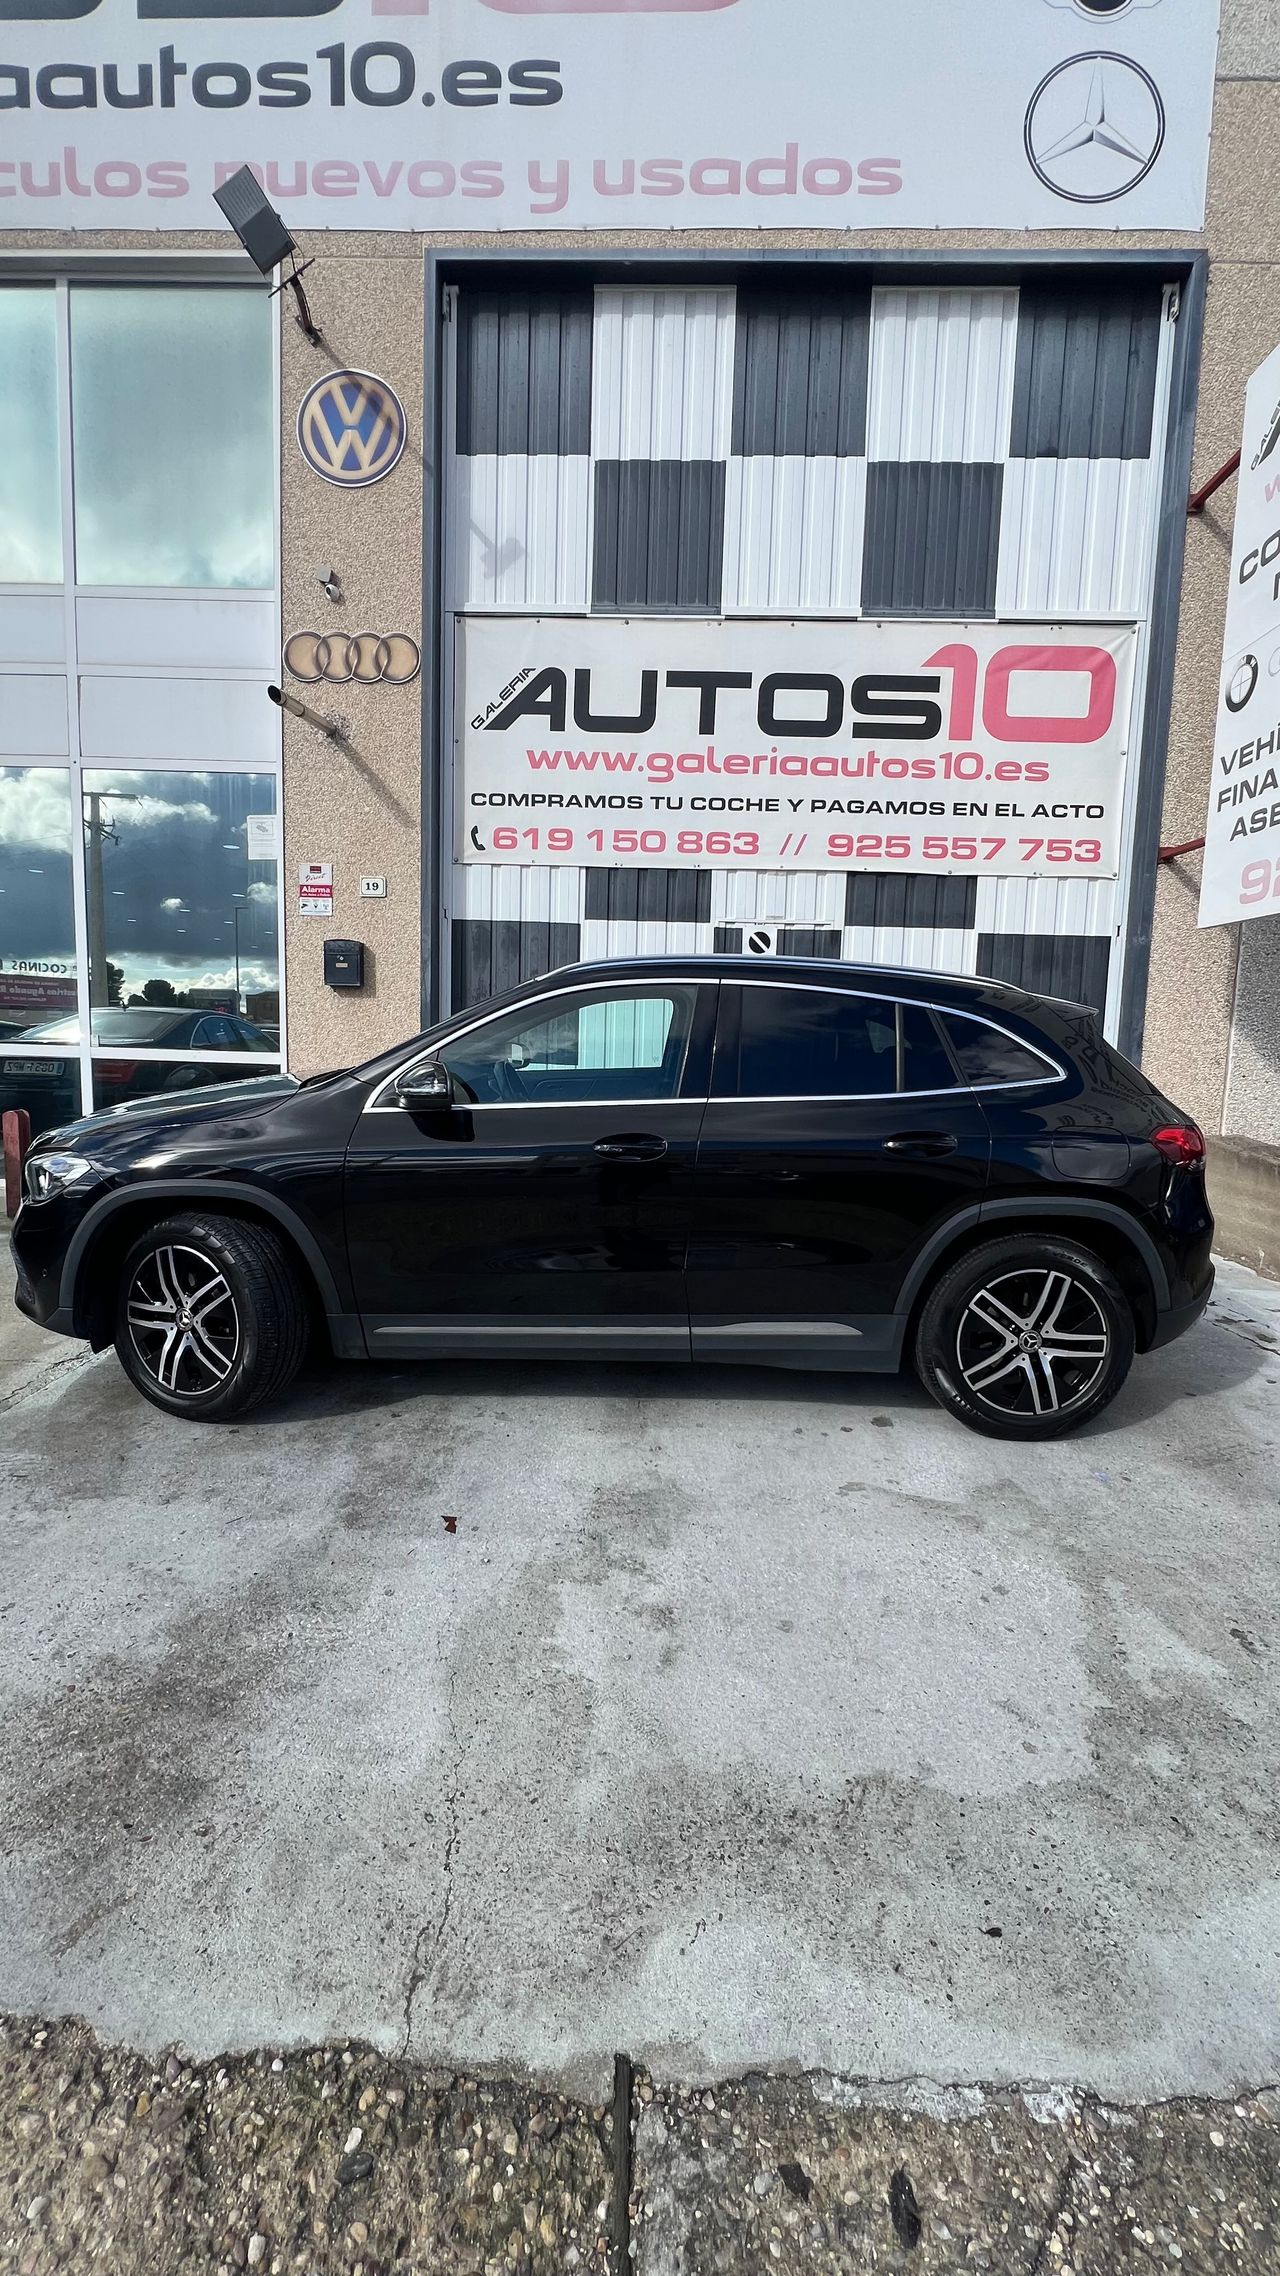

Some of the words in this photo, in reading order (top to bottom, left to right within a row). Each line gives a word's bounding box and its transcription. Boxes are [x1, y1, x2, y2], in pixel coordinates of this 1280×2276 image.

[214, 159, 504, 198] nuevos
[528, 160, 569, 214] y
[593, 143, 902, 196] usados
[470, 667, 536, 730] GALERIA
[482, 643, 1117, 743] AUTOS10
[526, 746, 1050, 783] www.galeriaautos10.es
[470, 792, 643, 809] COMPRAMOS
[650, 796, 683, 810] TU
[690, 797, 780, 812] COCHE
[787, 799, 805, 813] Y
[810, 799, 946, 816] PAGAMOS
[952, 802, 988, 817] EN
[995, 803, 1025, 818] EL
[1031, 804, 1105, 819] ACTO
[1217, 768, 1279, 812] FINA
[492, 827, 573, 850] 619
[586, 829, 666, 853] 150
[677, 831, 760, 855] 863
[827, 834, 911, 858] 925
[922, 836, 1006, 860] 557
[1018, 838, 1102, 863] 753
[365, 882, 379, 891] 19
[1239, 857, 1280, 904] 9
